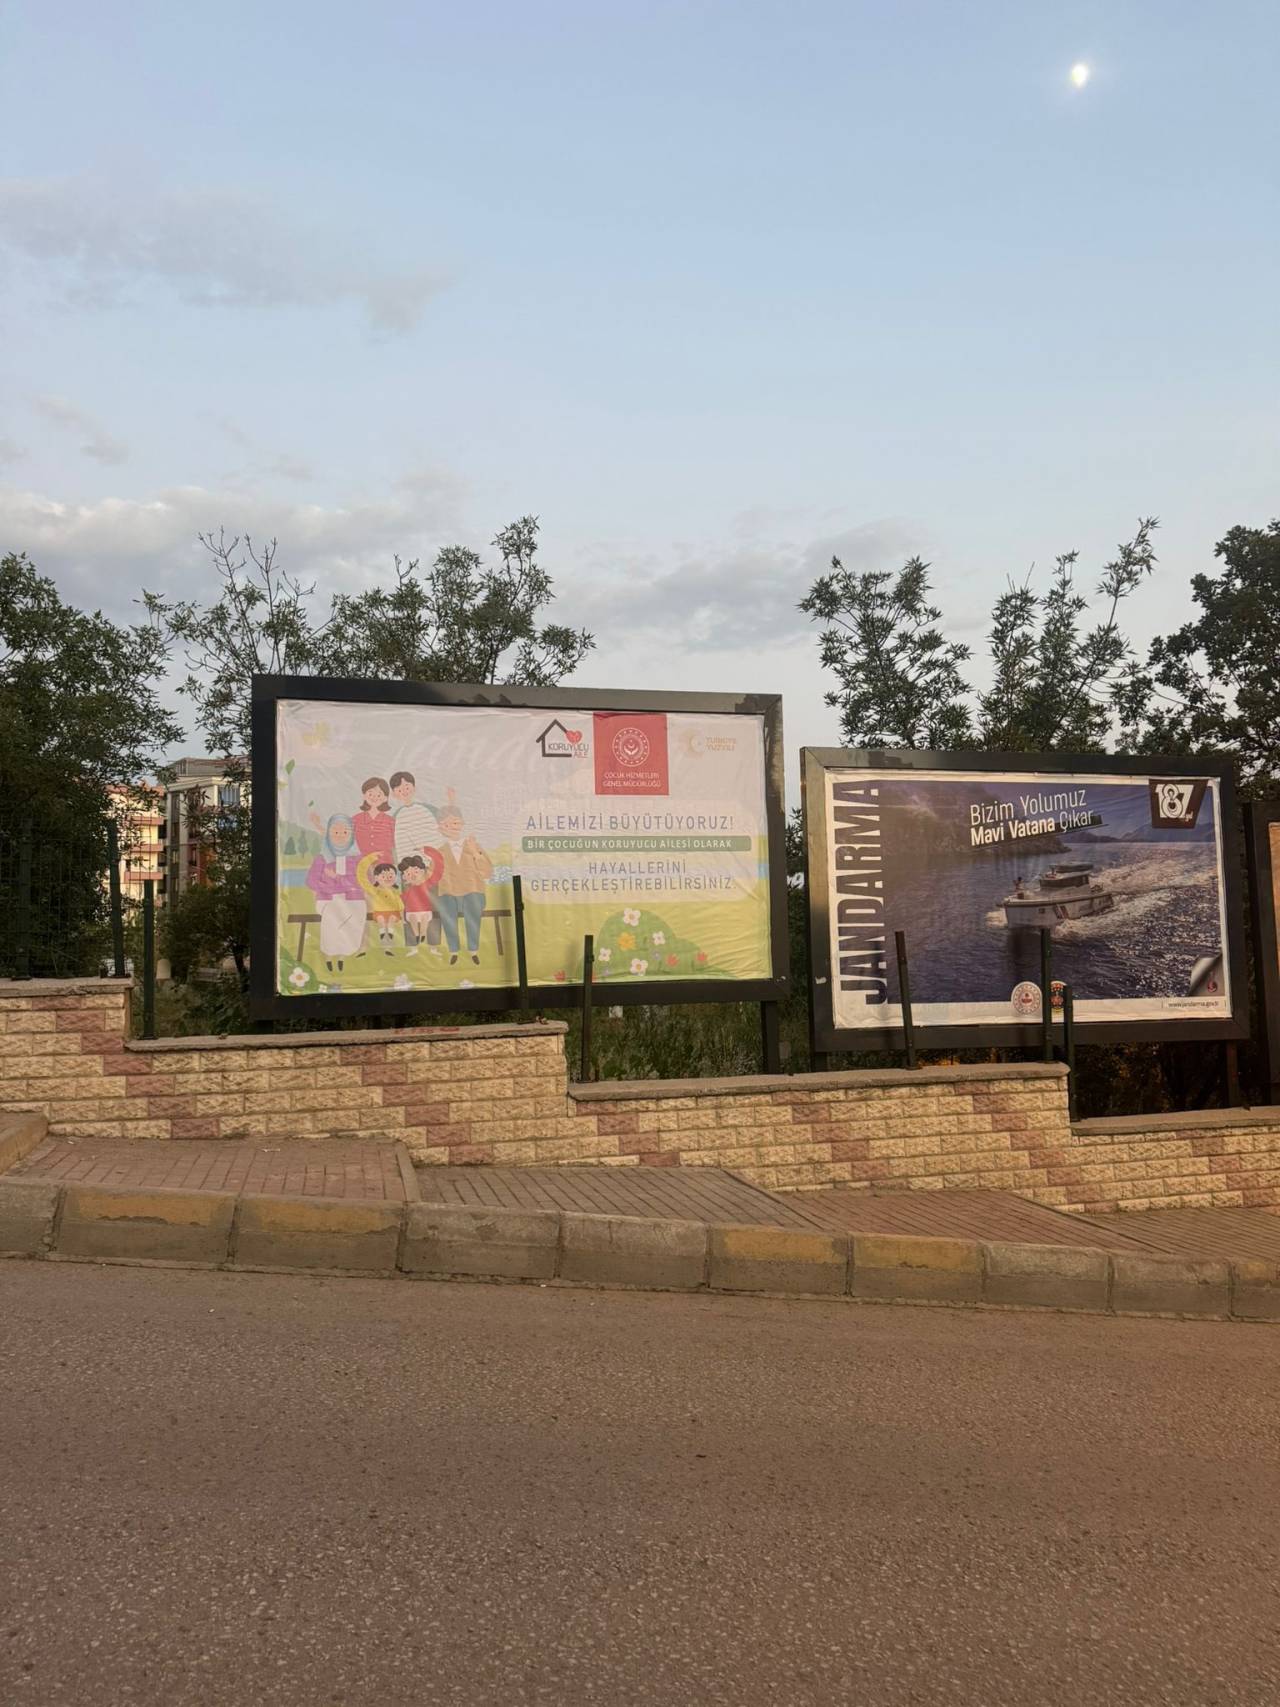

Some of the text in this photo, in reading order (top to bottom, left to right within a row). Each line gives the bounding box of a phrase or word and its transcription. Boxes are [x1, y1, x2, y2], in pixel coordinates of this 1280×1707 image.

[970, 789, 1087, 826] Bizim Yolumuz
[1155, 783, 1194, 819] 187
[526, 812, 734, 830] AİLEMİZİ BÜYÜTÜYORUZ!
[970, 810, 1094, 846] Mavi Vatana Çıkar
[527, 838, 732, 850] BİR ÇOCUĞUN KORUYUCU AİLESİ OLARAK
[588, 859, 686, 874] HAYALLERİNİ
[832, 779, 888, 1005] JANDARMA
